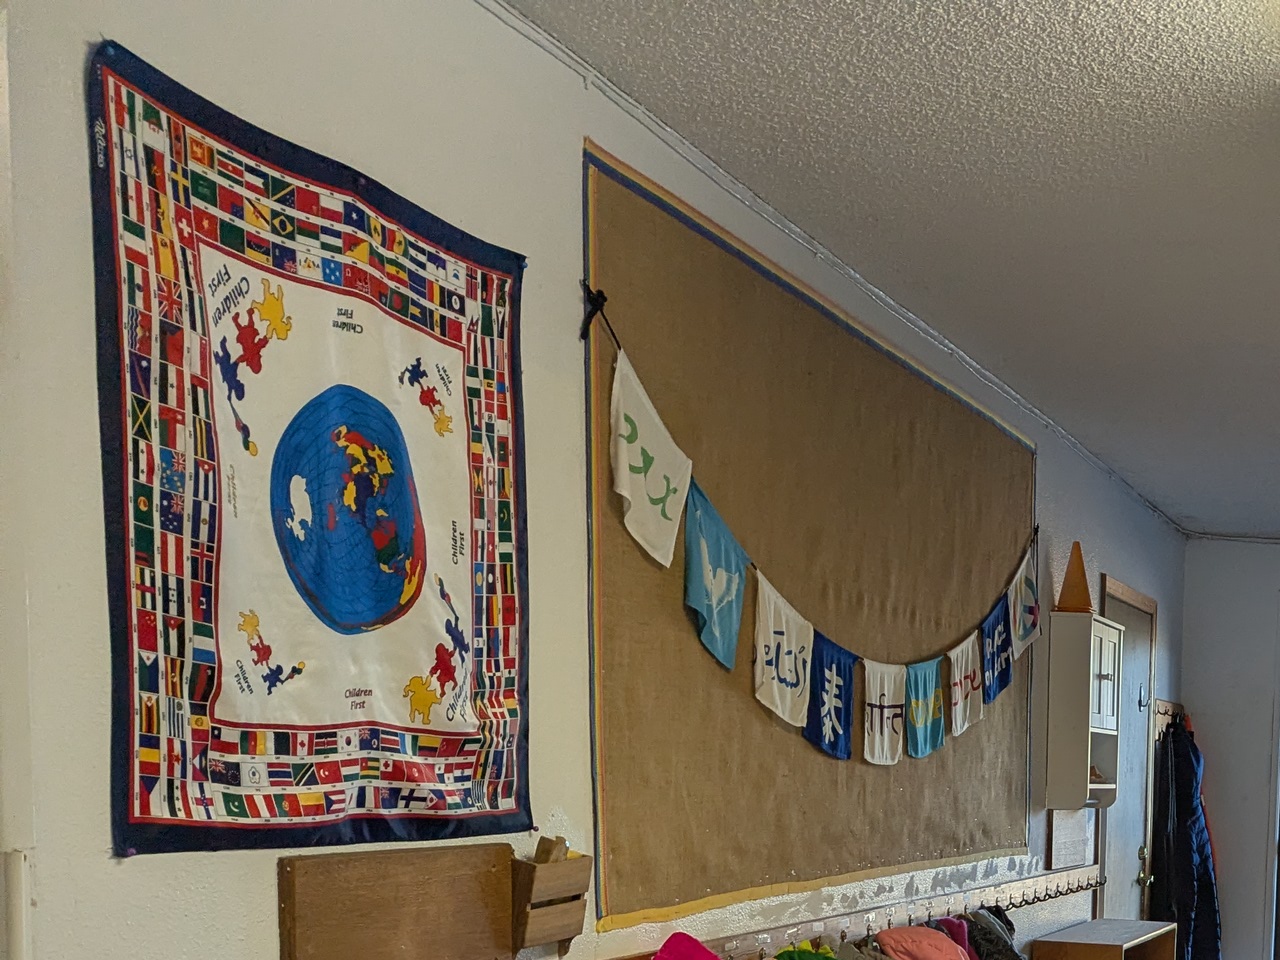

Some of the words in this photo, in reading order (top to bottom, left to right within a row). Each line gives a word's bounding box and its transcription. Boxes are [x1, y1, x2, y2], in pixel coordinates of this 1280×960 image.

[208, 263, 231, 297] First
[212, 277, 249, 328] Children
[332, 320, 363, 334] Children
[236, 660, 254, 695] Children
[345, 688, 373, 698] Children
[350, 700, 366, 710] First
